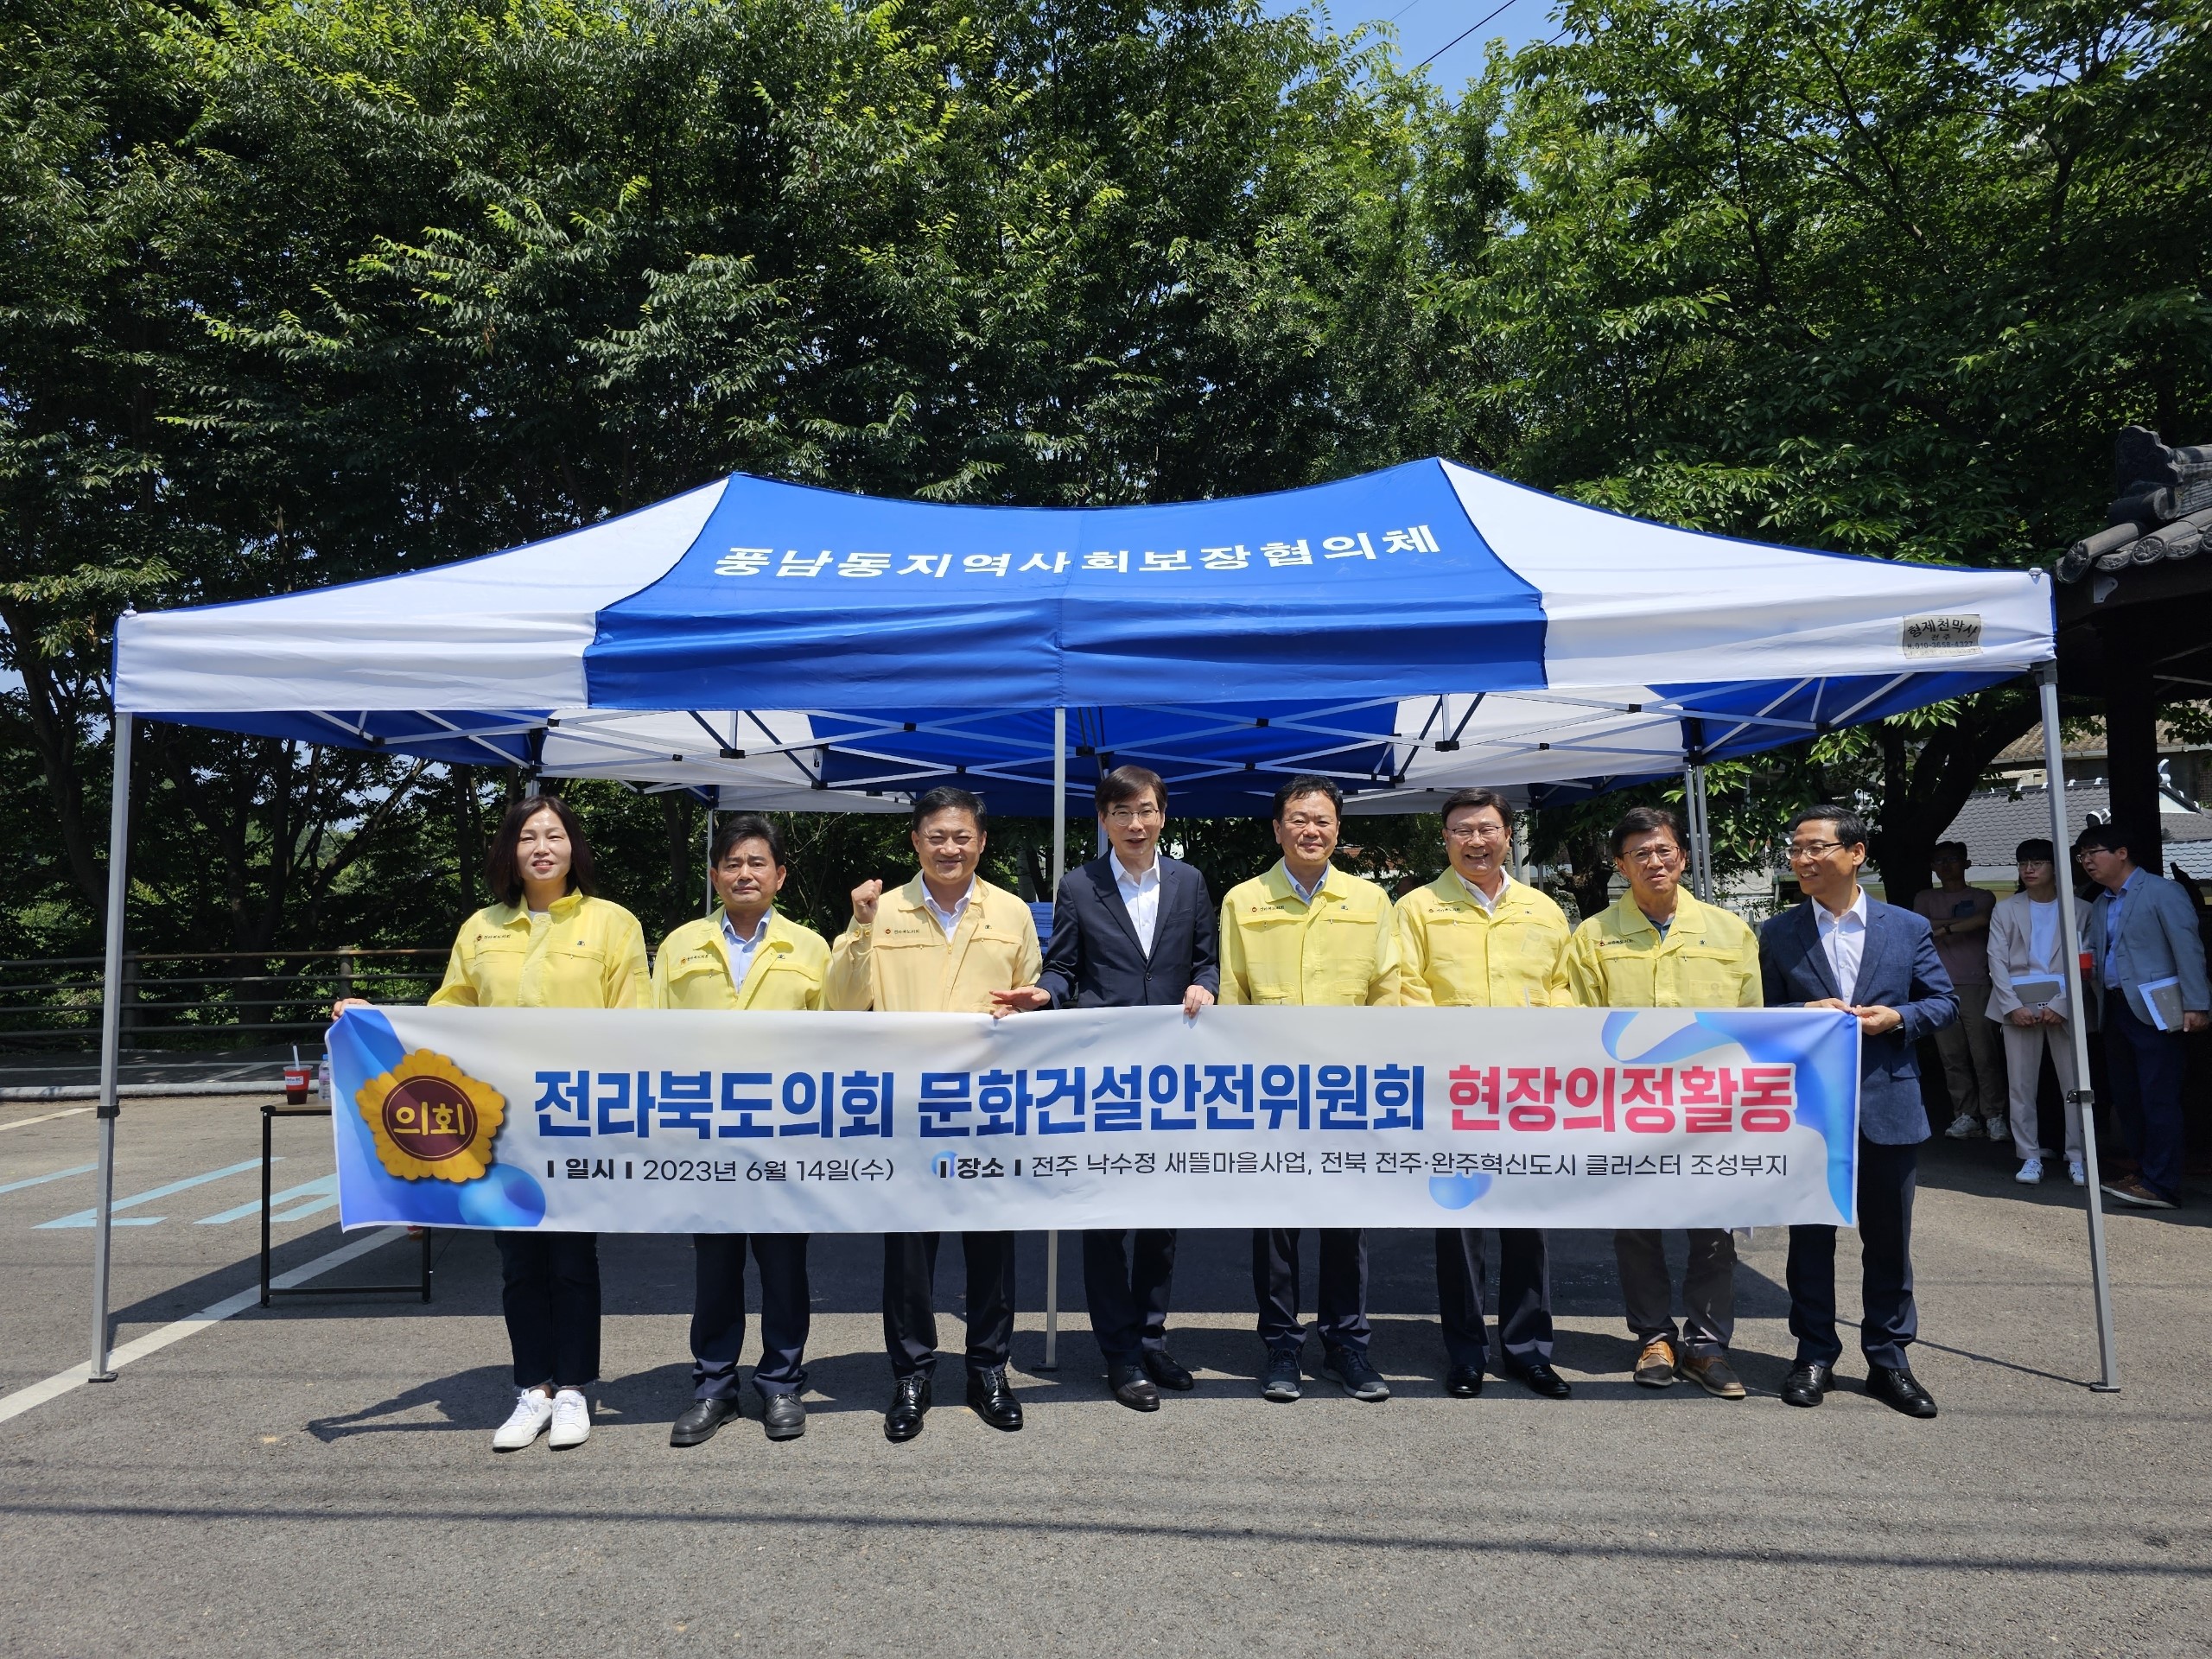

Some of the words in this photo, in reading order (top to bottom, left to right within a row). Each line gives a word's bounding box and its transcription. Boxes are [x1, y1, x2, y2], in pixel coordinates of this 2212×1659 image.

[713, 524, 1442, 579] 풍남동지역사회보장협의체
[1907, 618, 1979, 638] 형제천막사
[534, 1070, 894, 1140] 전라북도의회
[918, 1064, 1425, 1138] 문화건설안전위원회
[1449, 1064, 1793, 1134] 현장의정활동
[393, 1101, 466, 1136] 의회
[565, 1158, 614, 1179] 일시
[643, 1160, 736, 1181] 2023년
[746, 1160, 786, 1181] 6월
[796, 1159, 894, 1181] 14일(수)
[957, 1157, 1005, 1179] 장소
[1032, 1155, 1078, 1177] 전주
[1087, 1152, 1156, 1175] 낙수정
[1164, 1151, 1313, 1176] 새뜰마을사업,
[1320, 1151, 1367, 1173] 전북
[1586, 1154, 1681, 1176] 클러스터
[1690, 1154, 1787, 1177] 조성부지
